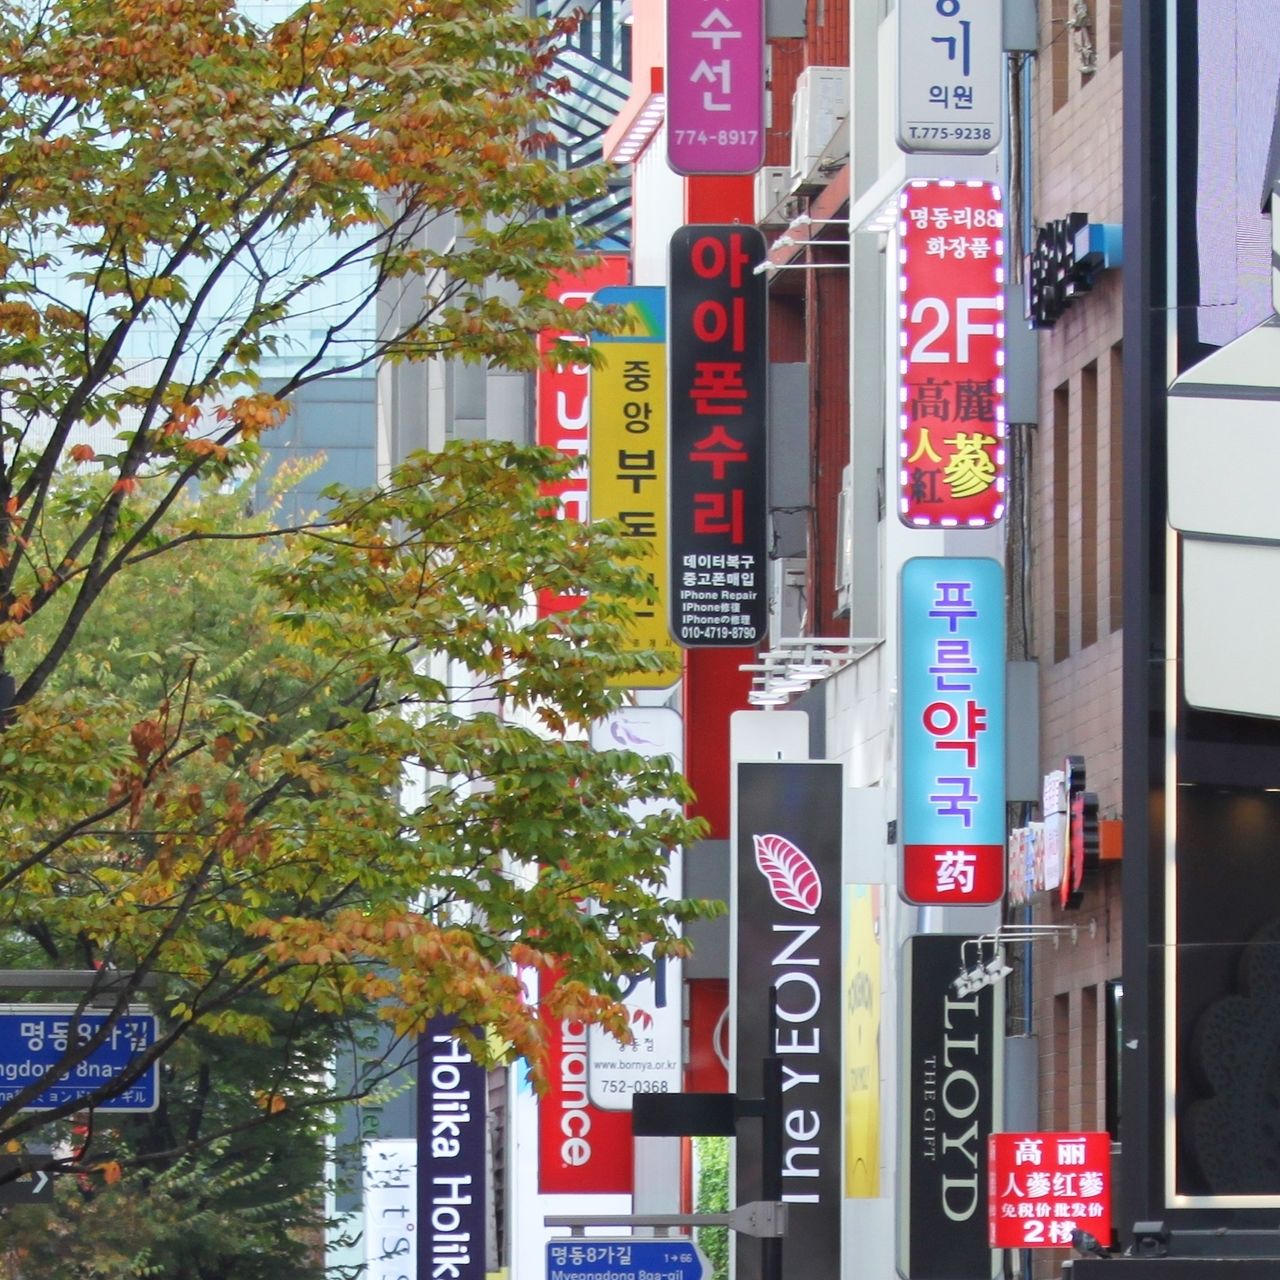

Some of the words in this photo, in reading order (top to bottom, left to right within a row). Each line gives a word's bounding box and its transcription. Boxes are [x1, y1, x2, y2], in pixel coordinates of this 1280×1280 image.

[929, 86, 975, 110] 의원
[675, 129, 758, 147] 774-8917
[908, 126, 992, 141] T.775-9238
[925, 236, 992, 260] 화장품
[910, 297, 999, 364] 2F
[688, 235, 749, 546] 아이폰수리
[910, 377, 997, 425] 高麗
[683, 554, 755, 569] 데이터복구
[683, 572, 755, 587] 중고폰매입
[721, 590, 758, 601] Repair
[681, 626, 757, 639] 010-4719-8790
[921, 581, 988, 829] 푸른약국
[934, 850, 977, 895] 药
[771, 924, 821, 1092] YEON
[76, 1060, 147, 1081] 8na-
[593, 1059, 677, 1071] www.bornya.or.kr
[601, 1080, 668, 1094] 752-0368
[922, 1055, 937, 1101] THE
[431, 1034, 472, 1158] Holika
[942, 995, 980, 1223] LLOYD
[922, 1107, 937, 1161] GIFT
[1013, 1137, 1087, 1166] 高丽
[551, 1246, 632, 1266] 명동8가길
